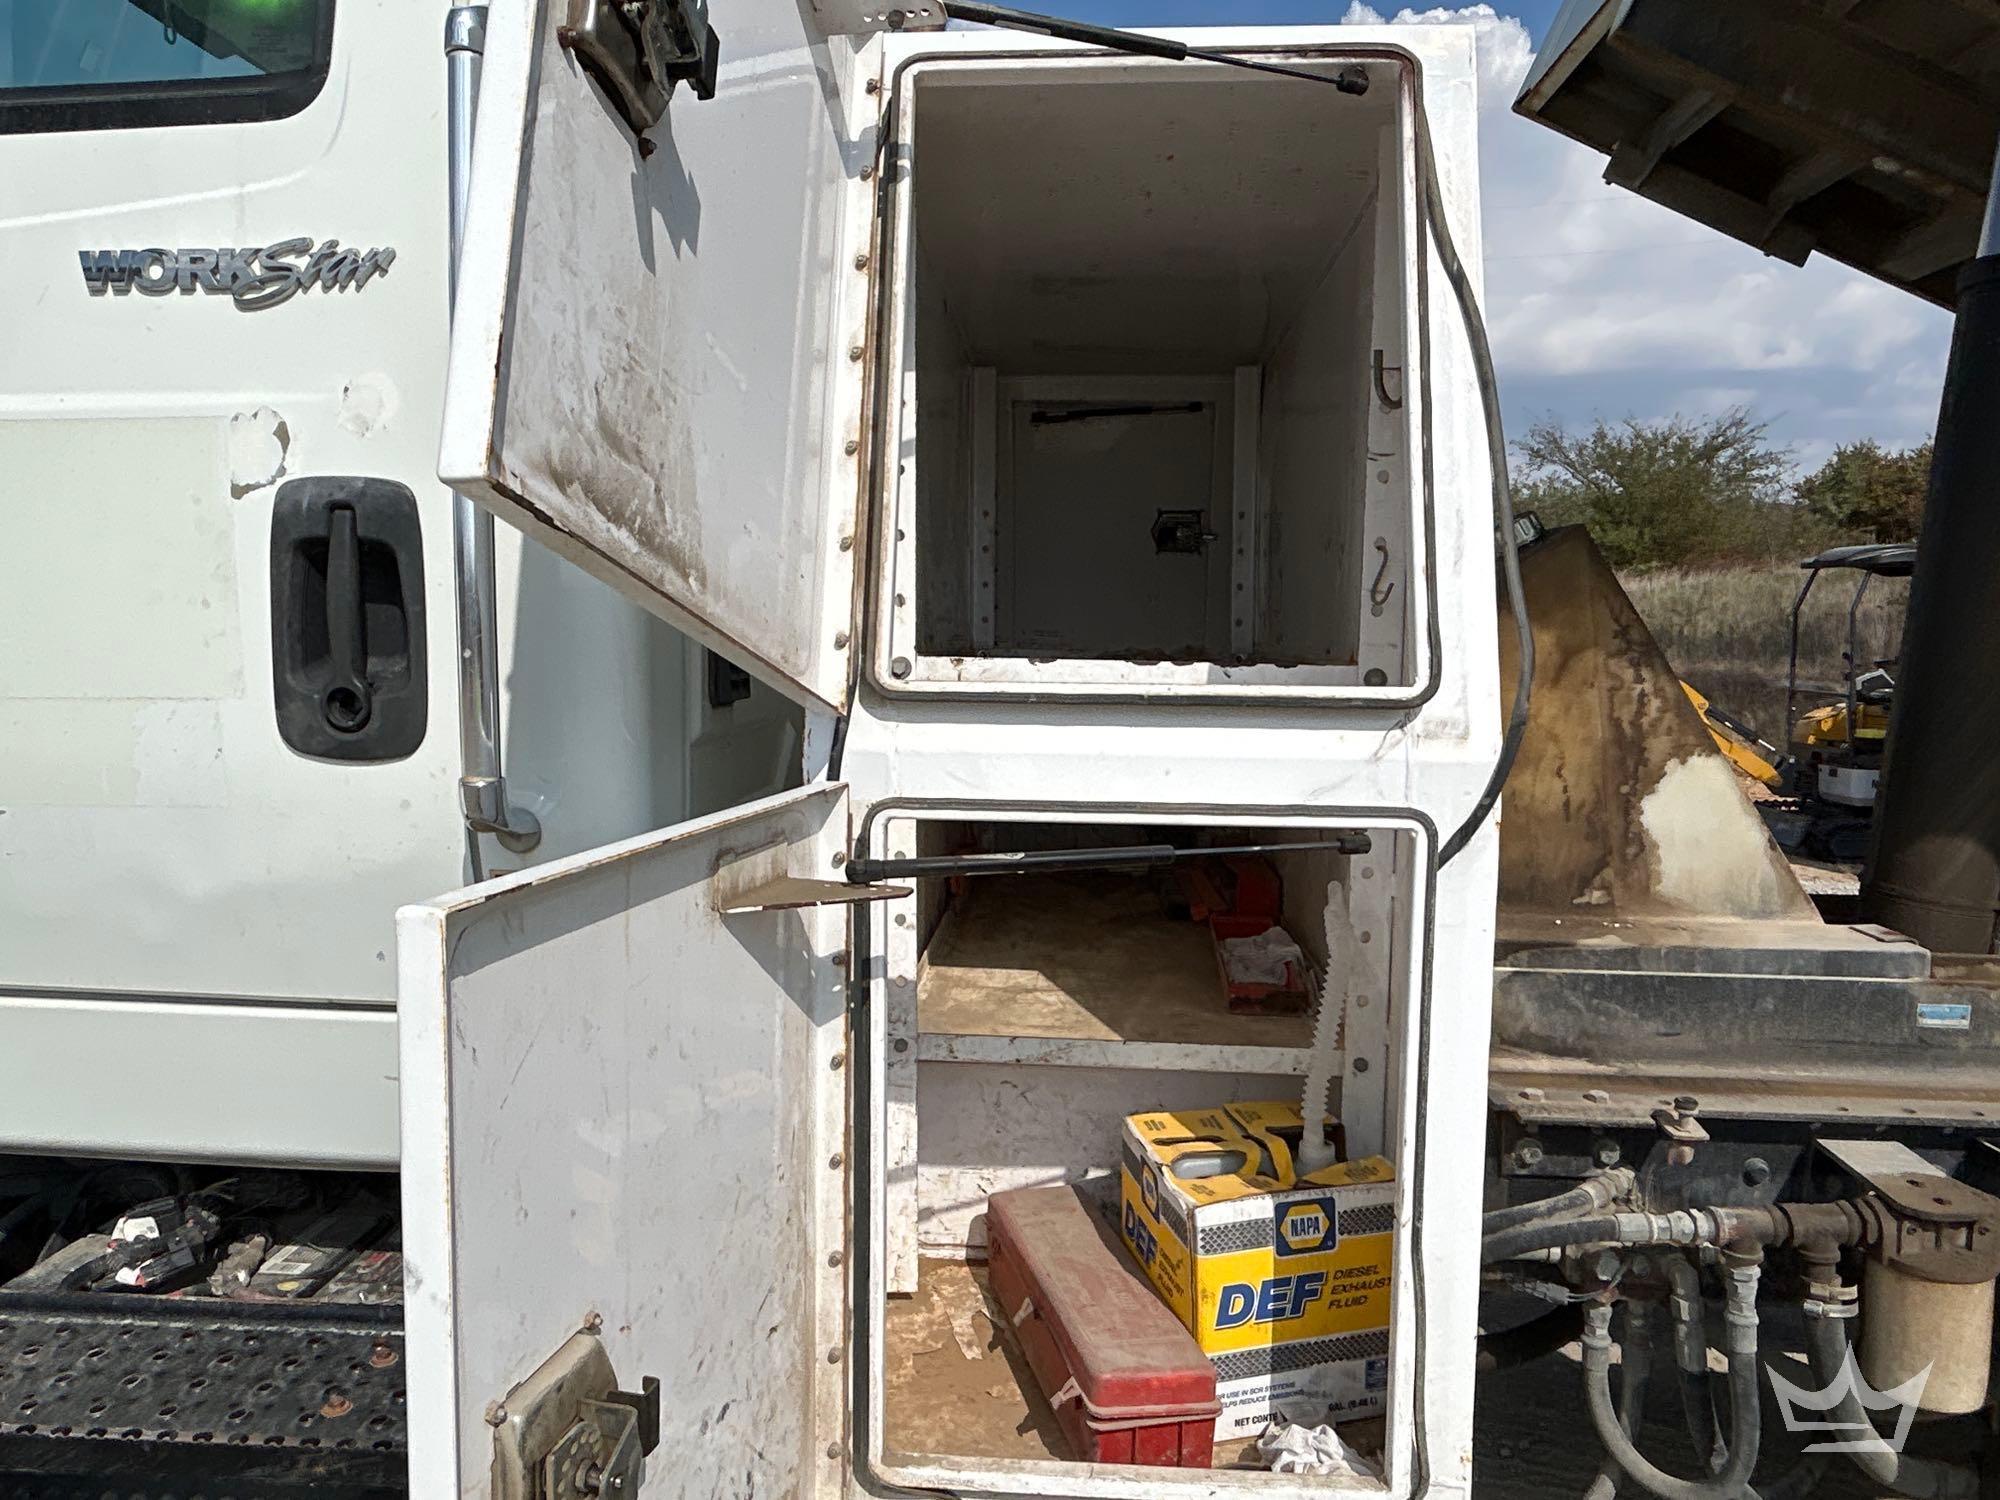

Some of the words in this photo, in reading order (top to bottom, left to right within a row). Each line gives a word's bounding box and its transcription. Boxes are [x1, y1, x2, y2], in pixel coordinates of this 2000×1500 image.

[1290, 1216, 1321, 1237] NAPA
[1333, 1264, 1380, 1281] DIESEL
[1330, 1276, 1392, 1295] EXHAUST
[1214, 1271, 1328, 1331] DEF
[1328, 1294, 1369, 1310] FLUID
[1226, 1390, 1240, 1399] USE
[1249, 1386, 1264, 1395] SCR
[1222, 1400, 1238, 1408] ELPS
[1238, 1395, 1267, 1406] REDUCE
[1234, 1416, 1251, 1427] NET
